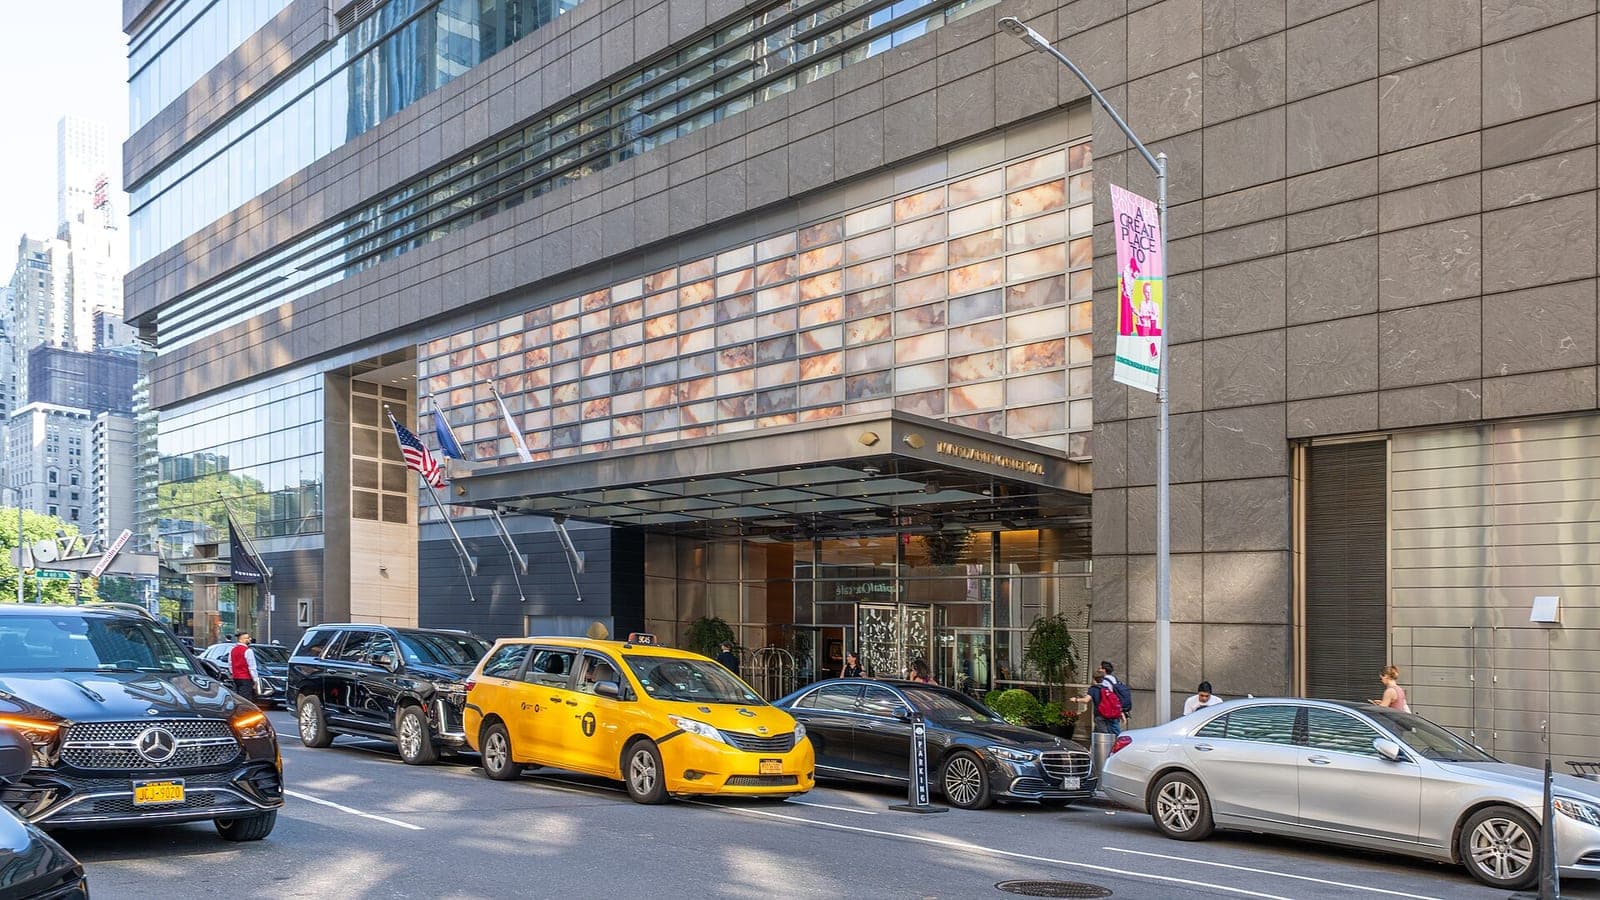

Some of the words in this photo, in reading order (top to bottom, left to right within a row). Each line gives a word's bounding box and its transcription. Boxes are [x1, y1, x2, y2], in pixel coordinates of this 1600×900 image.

[1120, 213, 1156, 239] GREAT
[1135, 206, 1144, 221] A
[1121, 227, 1156, 253] PLACE
[1130, 245, 1145, 263] TO
[918, 741, 926, 802] PARKING
